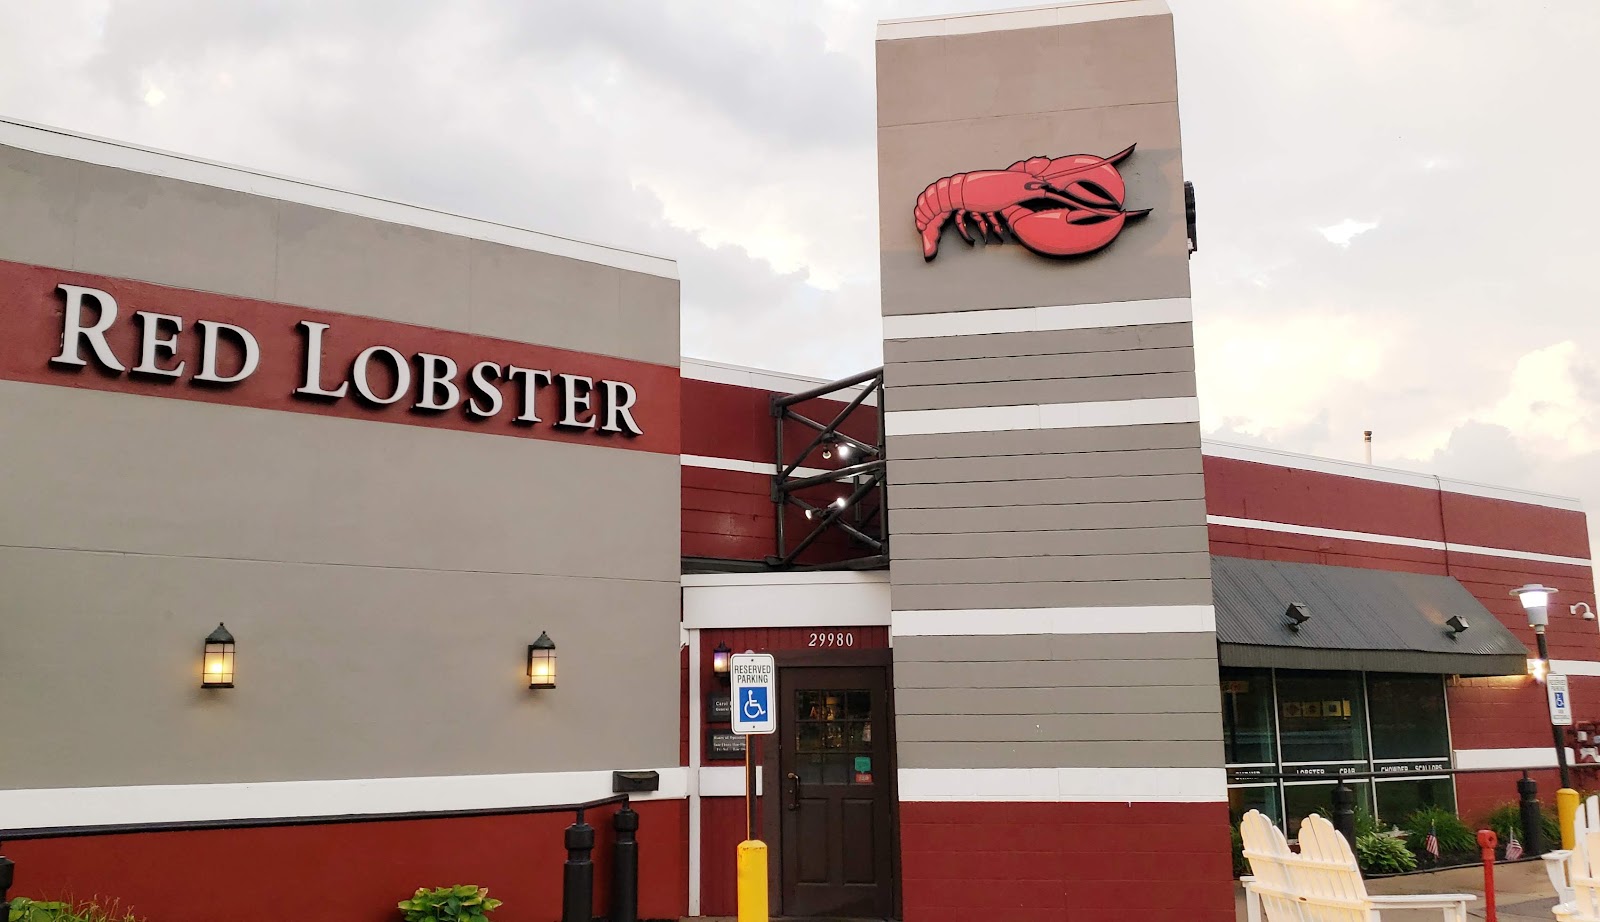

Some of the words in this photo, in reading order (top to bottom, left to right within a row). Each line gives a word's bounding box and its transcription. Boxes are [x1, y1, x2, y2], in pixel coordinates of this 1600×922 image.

[51, 283, 260, 383] RED
[293, 320, 644, 436] LOBSTER
[808, 632, 854, 647] 29980
[734, 664, 771, 674] RESERVED
[737, 674, 769, 684] PARKING
